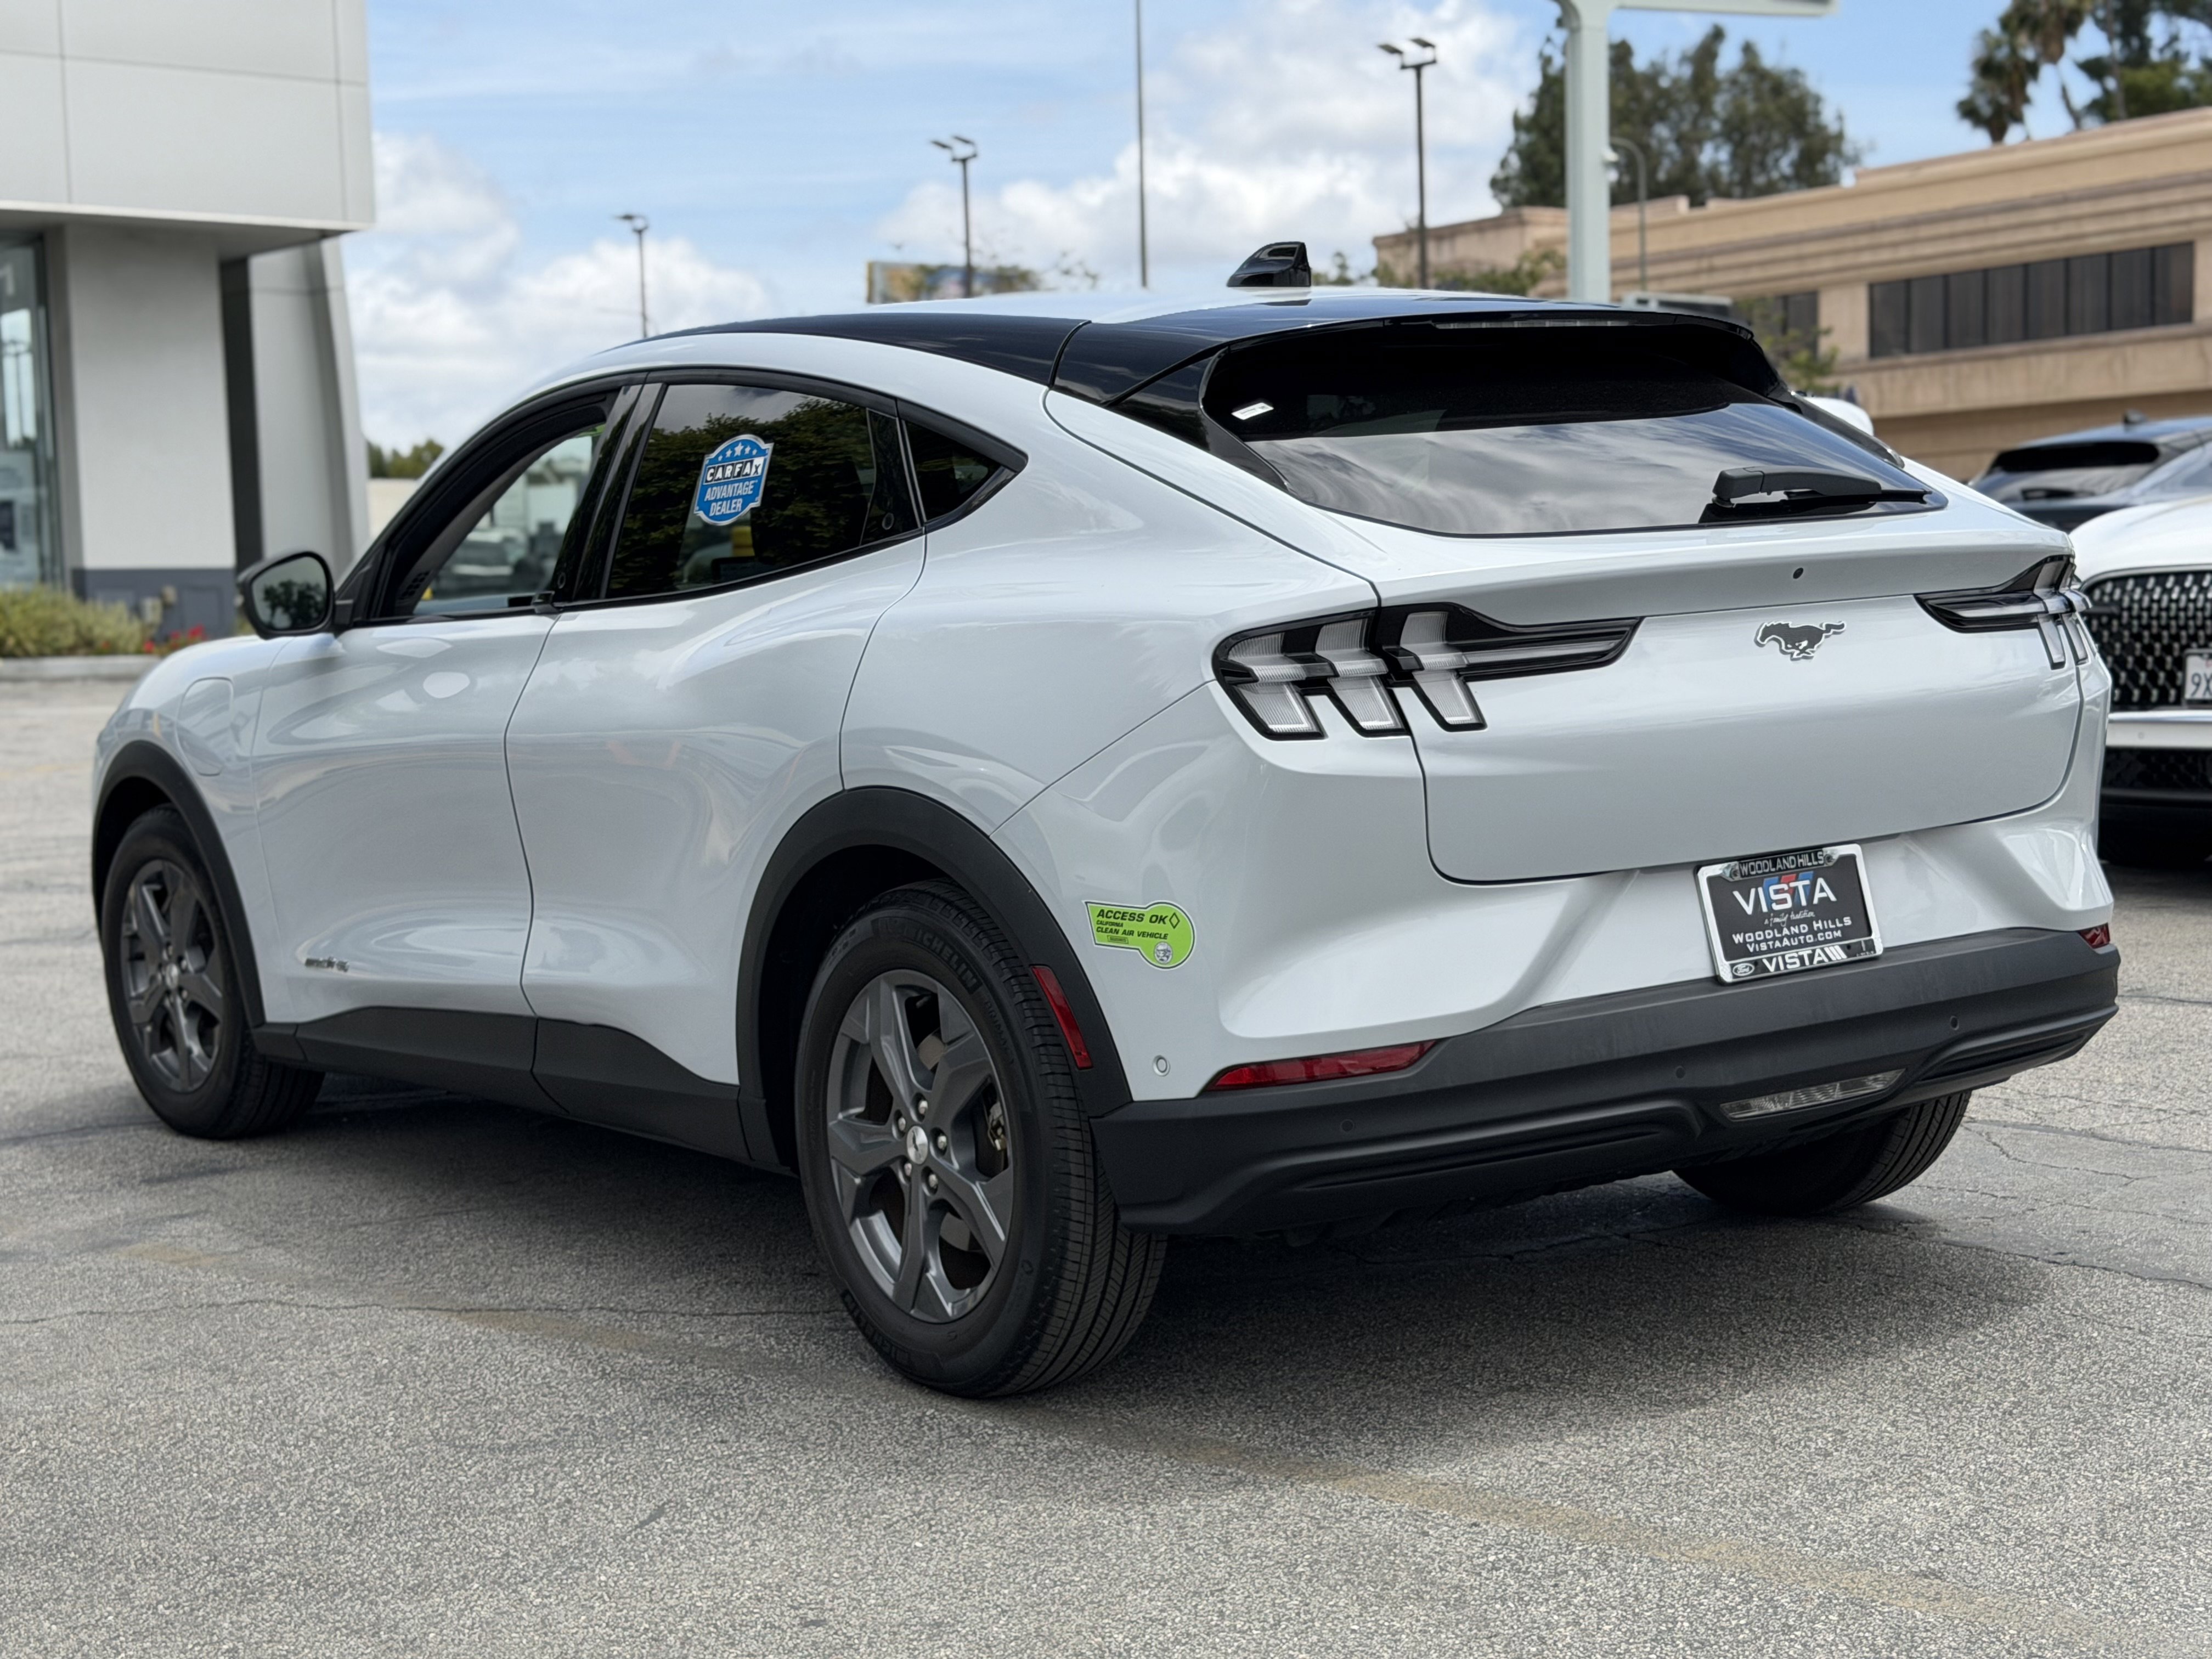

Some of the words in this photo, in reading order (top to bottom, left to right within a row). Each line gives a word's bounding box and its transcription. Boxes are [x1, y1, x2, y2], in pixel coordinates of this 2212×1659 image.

[706, 464, 761, 481] CARFAX
[704, 482, 754, 501] ADVANTAGE
[709, 499, 743, 516] DEALER
[1740, 856, 1796, 876] WOODLAND
[1797, 851, 1825, 867] HILLS
[1733, 878, 1837, 915] VISTA
[1096, 919, 1124, 928] CALIFORNIA
[1097, 909, 1145, 922] ACCESS
[1149, 915, 1169, 924] OK
[1096, 926, 1119, 935] CLEAN
[1137, 930, 1169, 940] VEHICLE
[1732, 924, 1809, 944] WOODLAND
[1813, 916, 1852, 931] HILLS
[1747, 930, 1842, 953] VISTAAUTO.COM
[1762, 948, 1829, 973] VISTA
